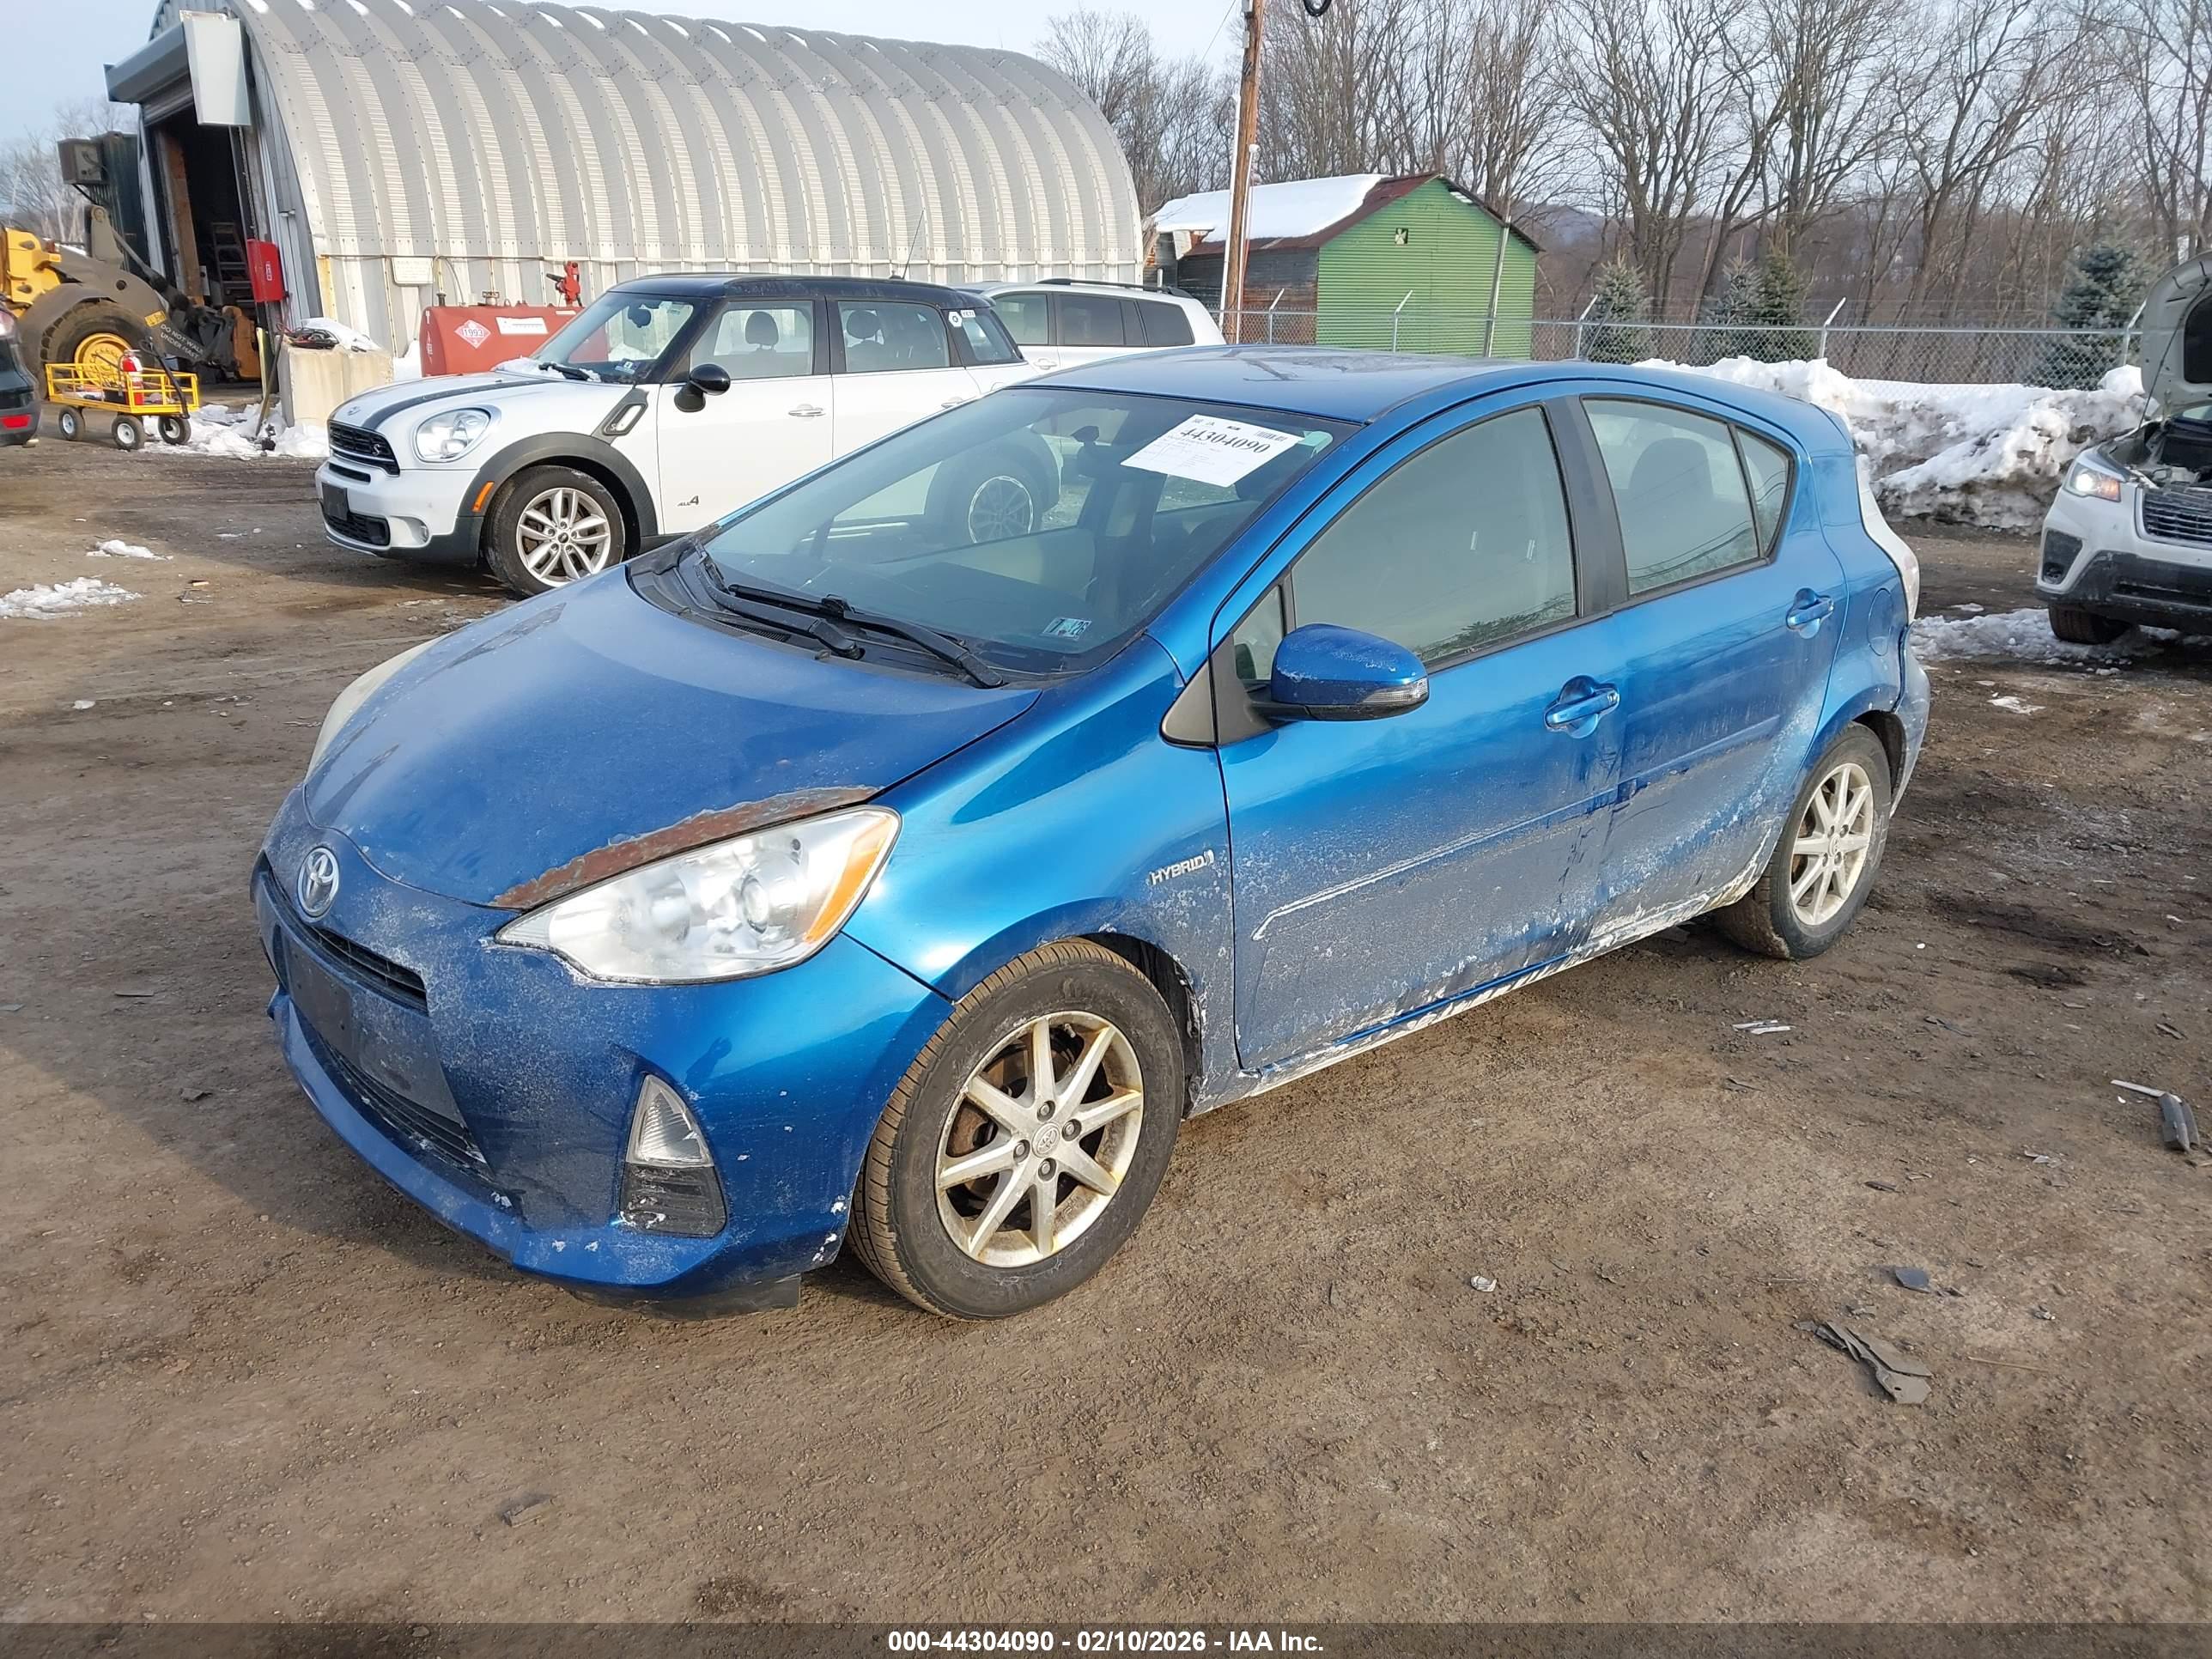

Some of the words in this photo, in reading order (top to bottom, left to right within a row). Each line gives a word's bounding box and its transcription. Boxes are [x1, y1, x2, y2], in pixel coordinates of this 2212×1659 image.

[161, 324, 172, 333] DO
[172, 331, 186, 343] NOT
[1180, 427, 1271, 453] 44304090
[1151, 855, 1206, 886] HYBRID
